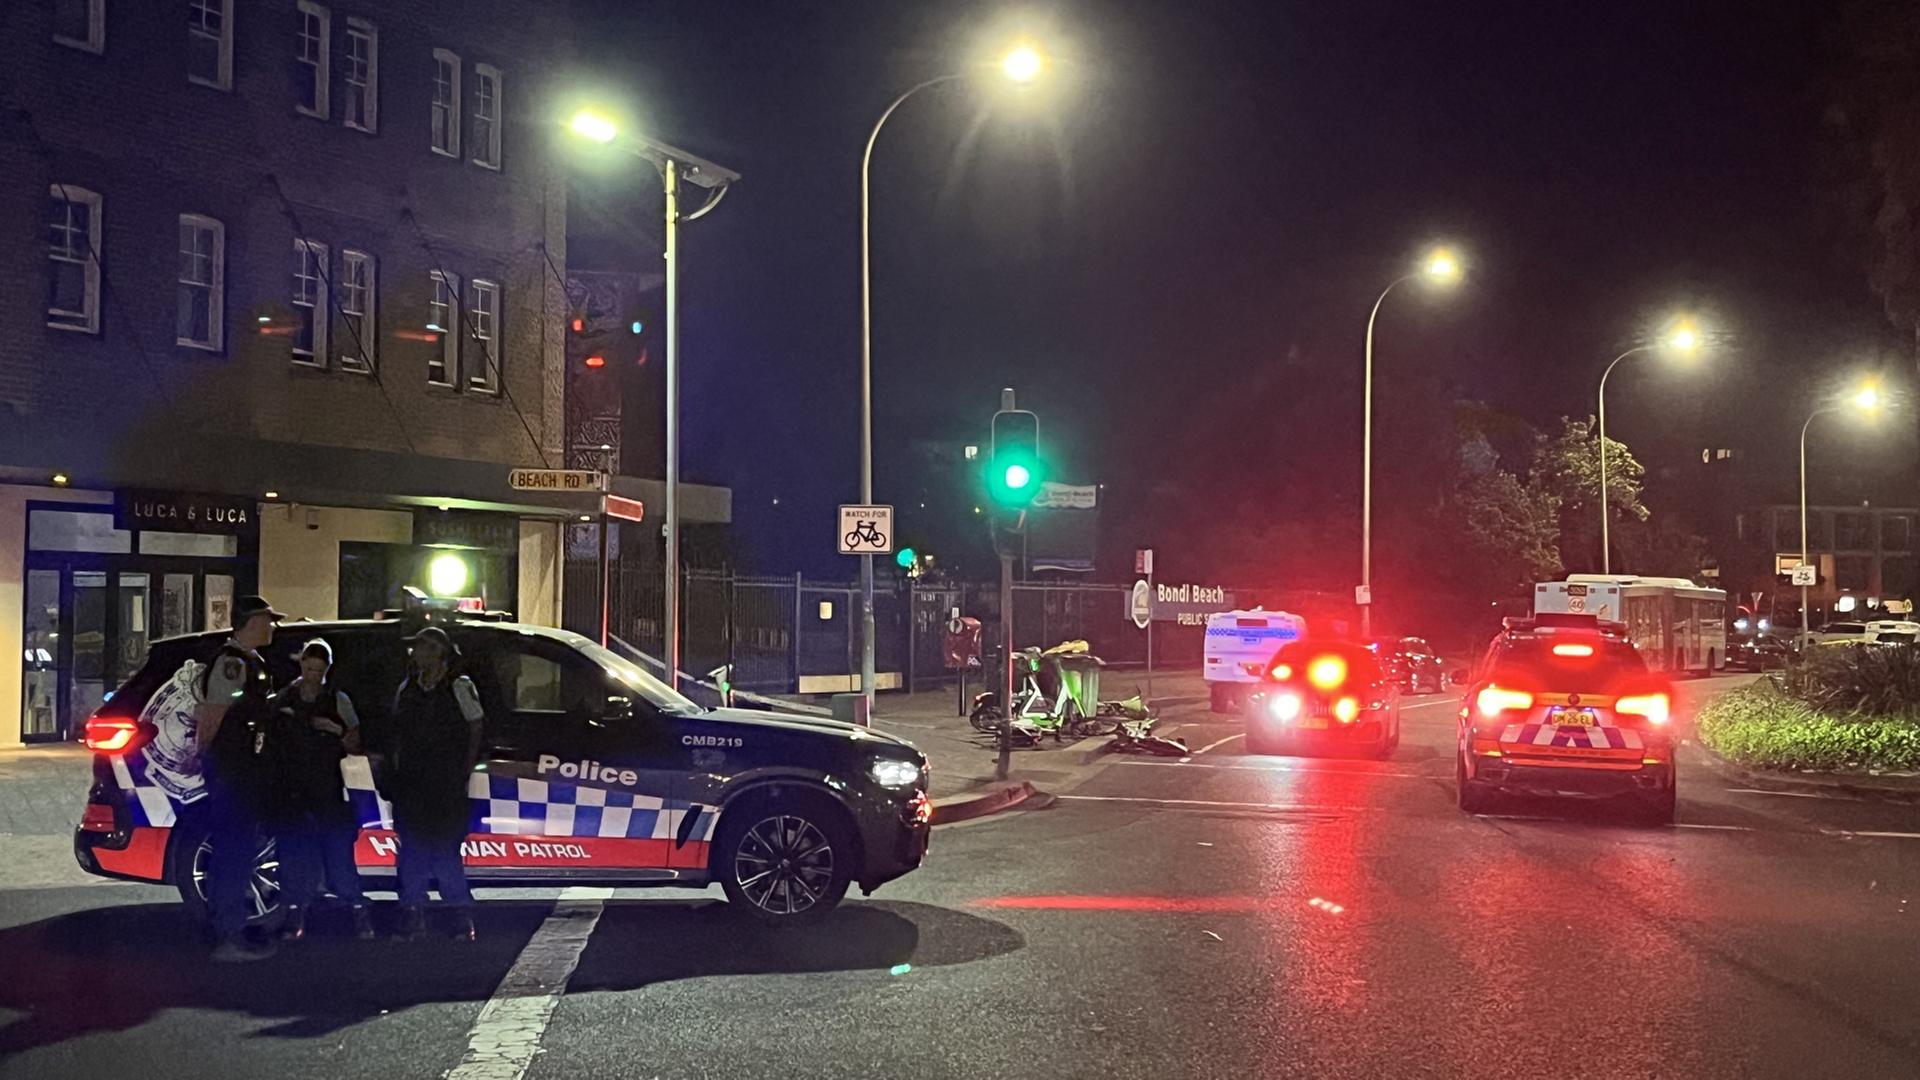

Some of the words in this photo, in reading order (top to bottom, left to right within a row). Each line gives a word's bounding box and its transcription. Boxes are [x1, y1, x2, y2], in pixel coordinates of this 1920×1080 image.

[518, 473, 557, 488] BEACH
[563, 474, 581, 488] RD
[134, 502, 178, 518] LUCA
[206, 508, 247, 523] LUCA
[845, 510, 870, 518] WATCH
[872, 510, 887, 518] FOR
[1157, 583, 1190, 602] Bondi
[1192, 585, 1224, 603] Beach
[1573, 599, 1584, 609] 40
[1177, 613, 1202, 625] PUBLIC
[682, 735, 743, 747] CMB219
[538, 755, 639, 785] Police
[369, 836, 507, 858] HWAY
[517, 842, 591, 860] PATROL
